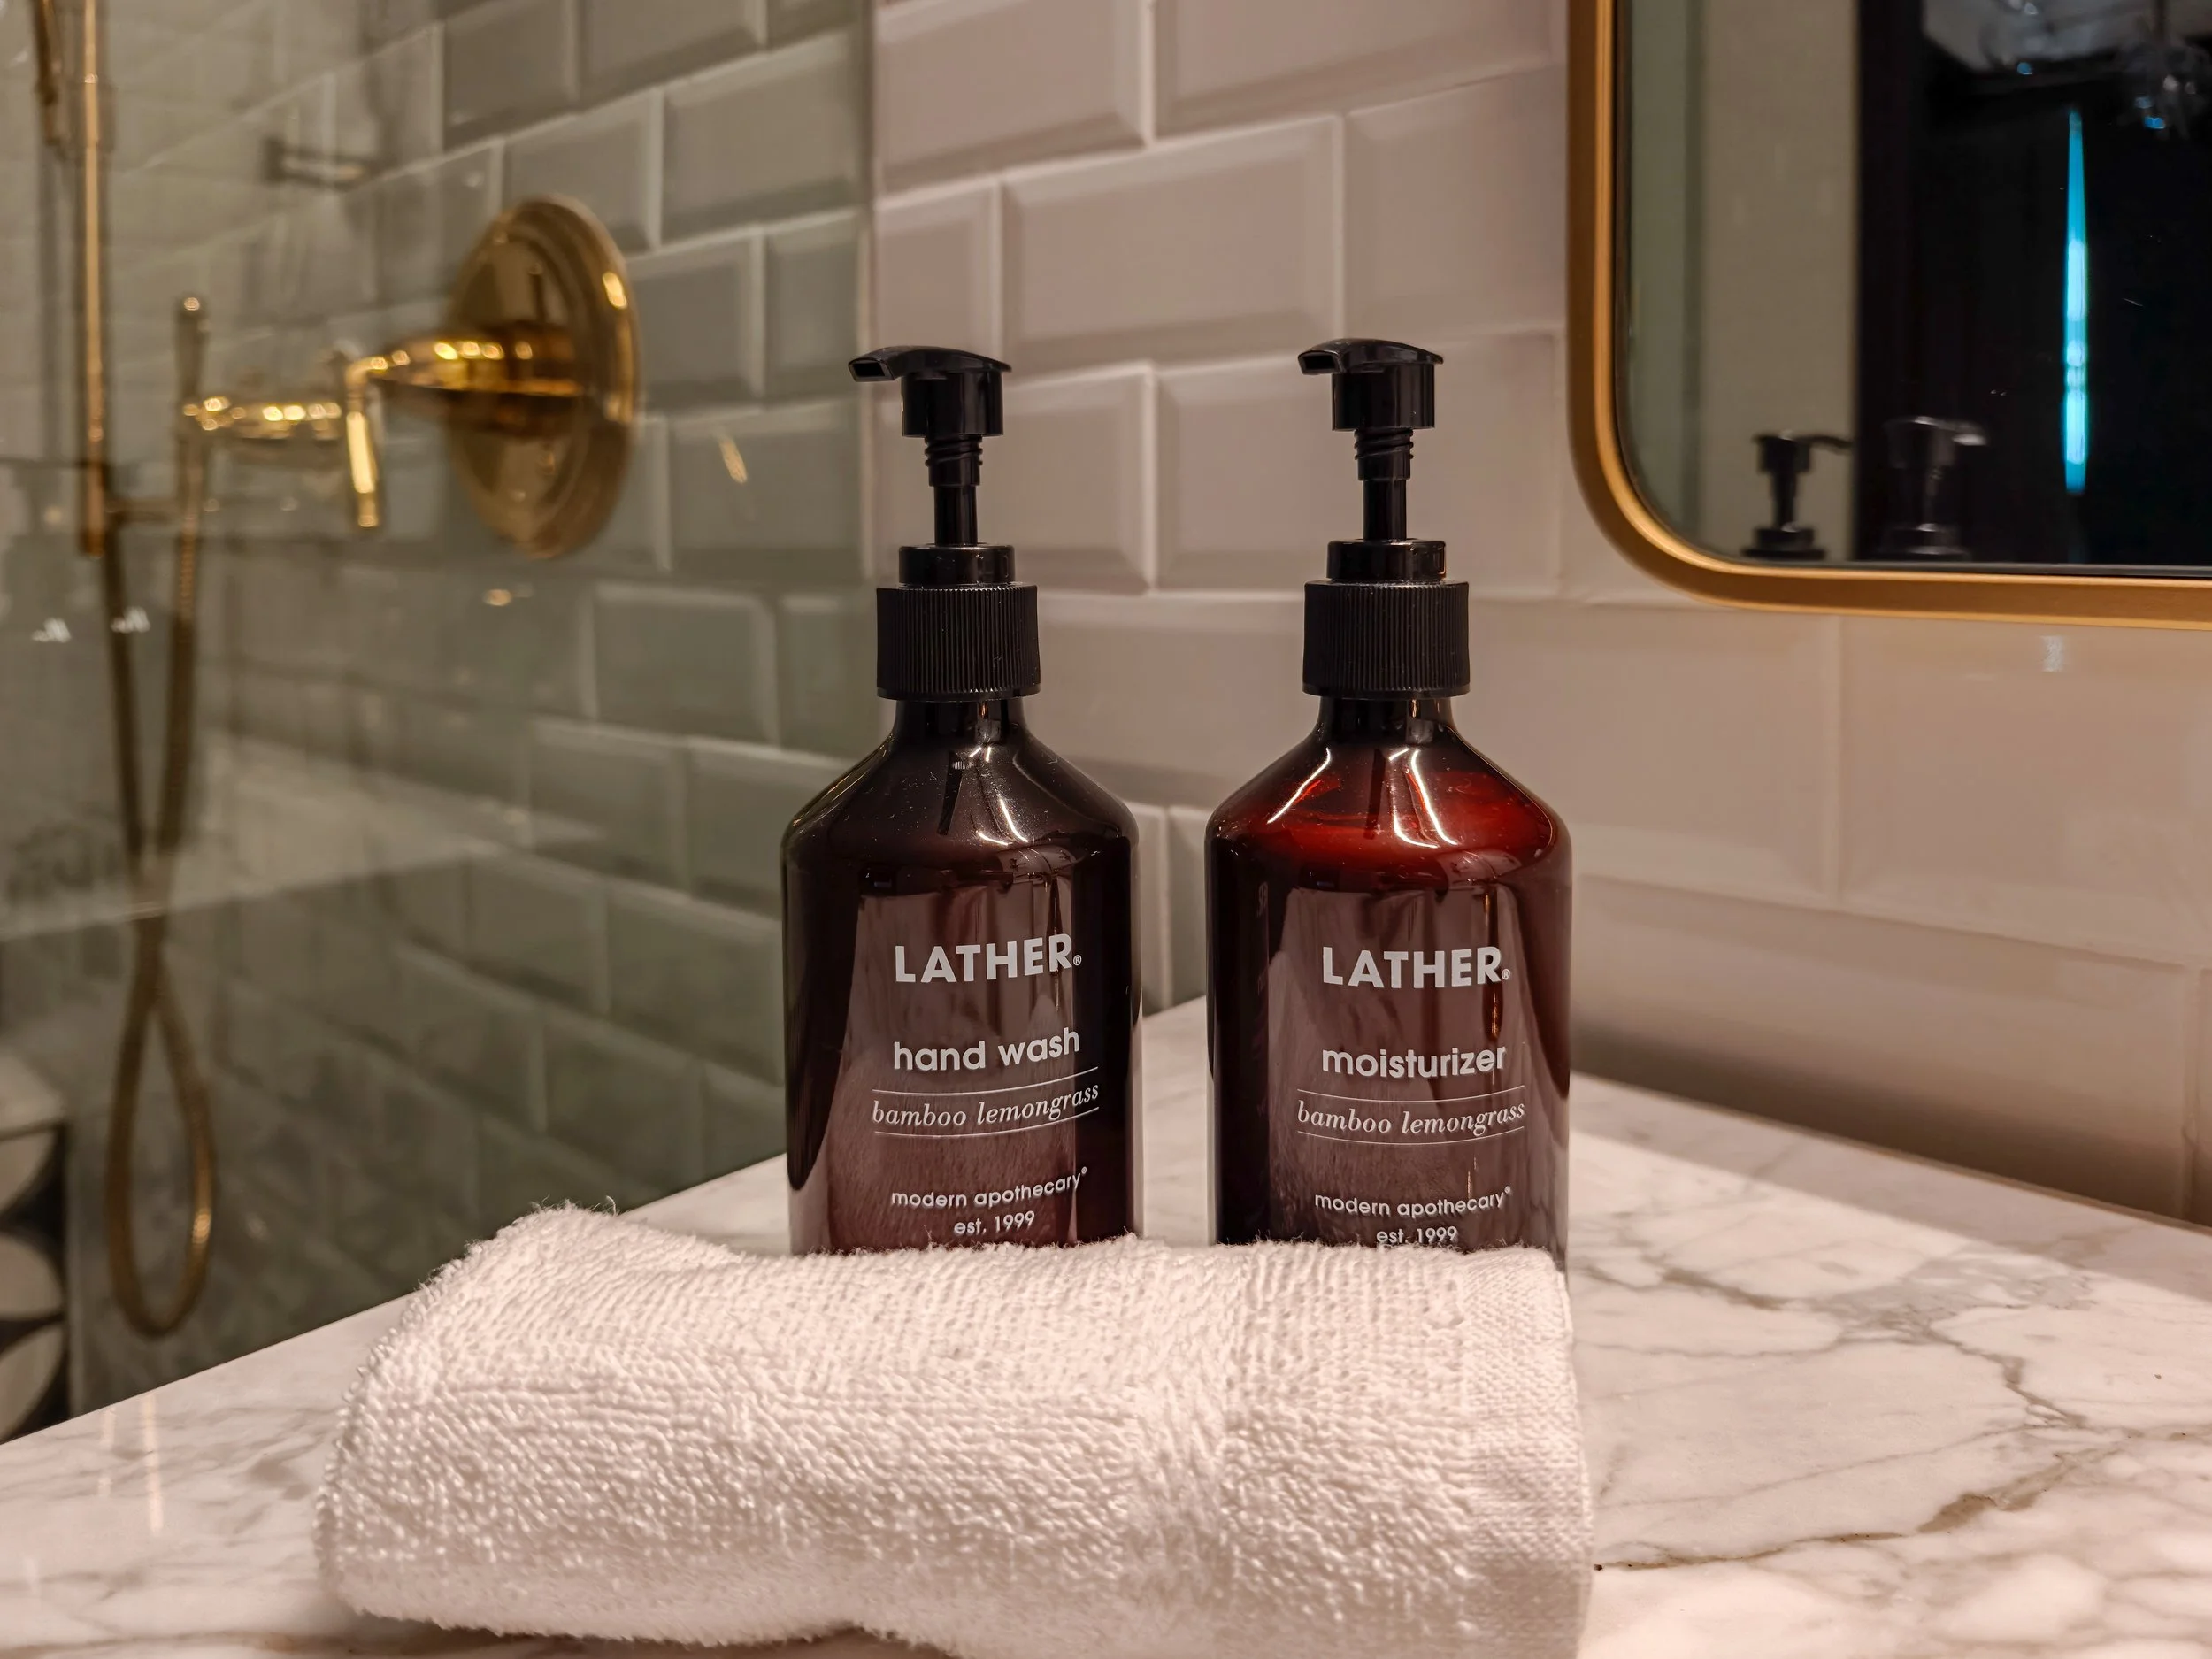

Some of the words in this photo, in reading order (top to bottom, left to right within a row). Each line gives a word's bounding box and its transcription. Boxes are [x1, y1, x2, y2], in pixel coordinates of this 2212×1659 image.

[894, 1041, 986, 1071] hand
[998, 1027, 1079, 1065] wash
[1322, 1046, 1507, 1078] moisturizer
[872, 1101, 966, 1126] bamboo
[977, 1083, 1099, 1125] lemongrass
[1297, 1100, 1392, 1133] bamboo
[1402, 1103, 1525, 1136] lemongrass
[891, 1191, 967, 1208] modern
[1315, 1194, 1390, 1216] modern
[953, 1217, 987, 1235] est.
[994, 1210, 1035, 1232] 1999
[1417, 1226, 1457, 1243] 1999
